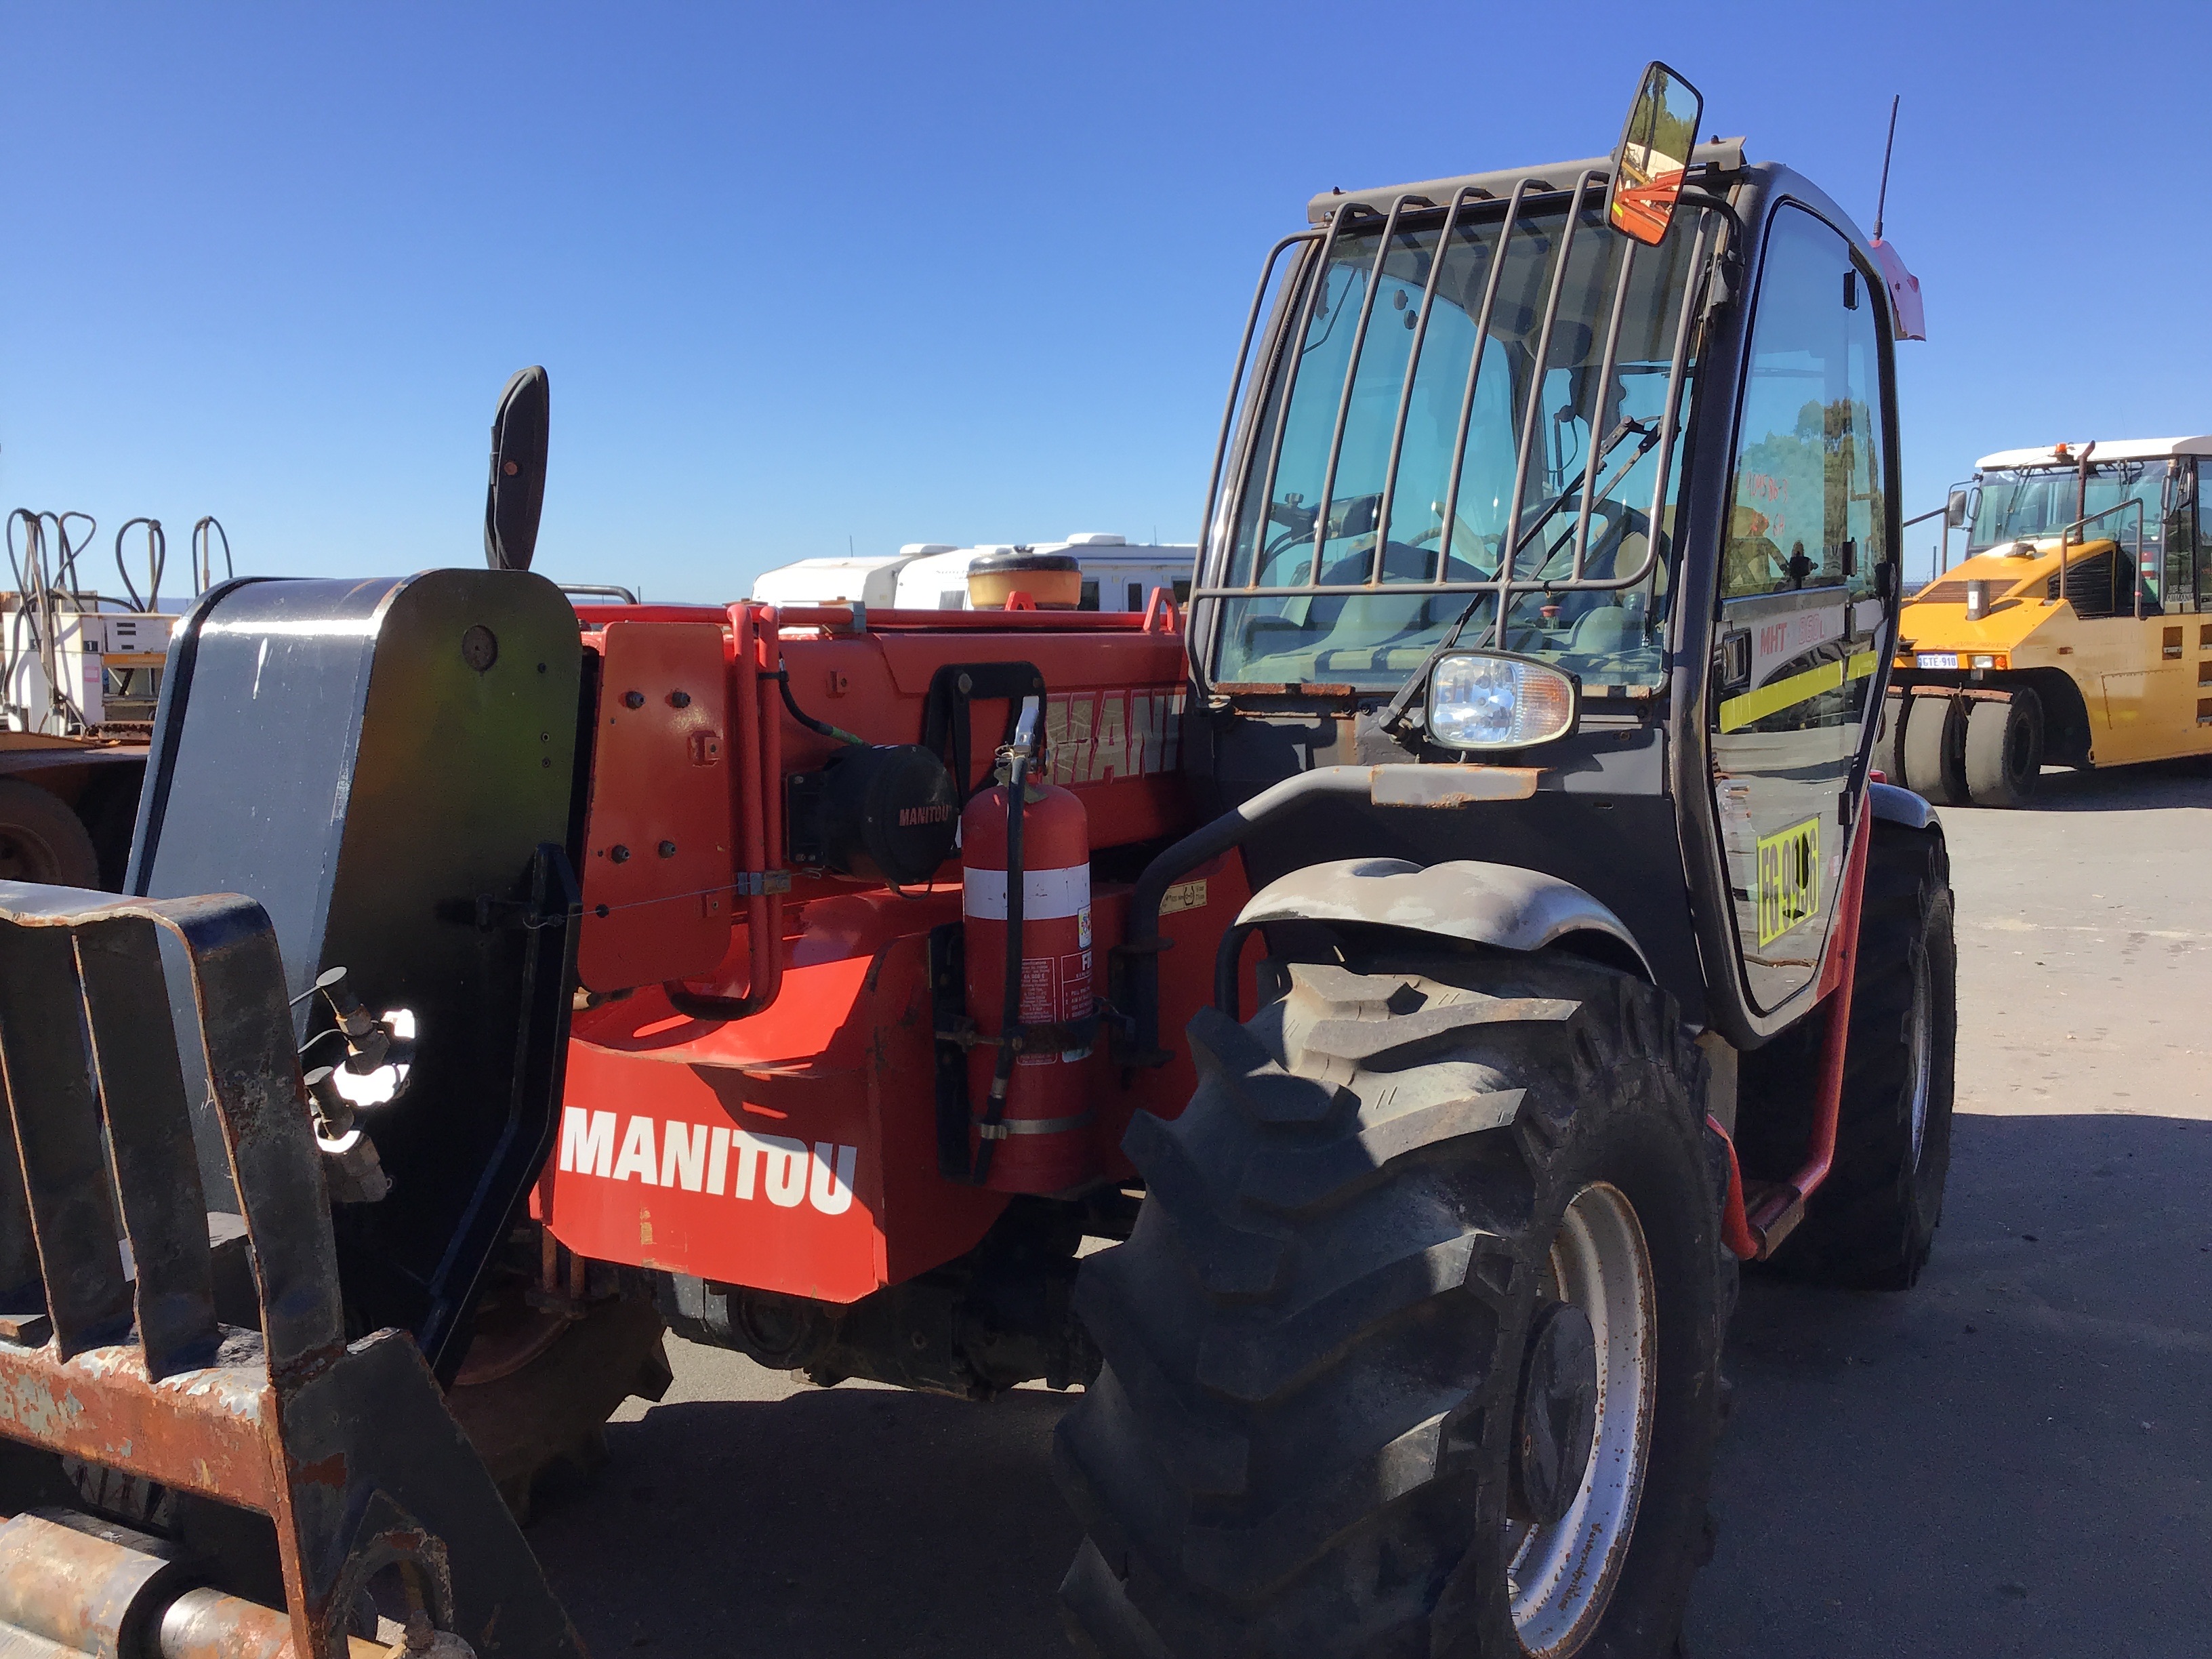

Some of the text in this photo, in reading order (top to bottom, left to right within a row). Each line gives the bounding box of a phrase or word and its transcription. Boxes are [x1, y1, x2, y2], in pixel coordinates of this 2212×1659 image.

[1761, 622, 1788, 657] MHT
[1042, 691, 1186, 785] MANI
[899, 804, 949, 826] MANITOU
[559, 1106, 857, 1215] MANITOU
